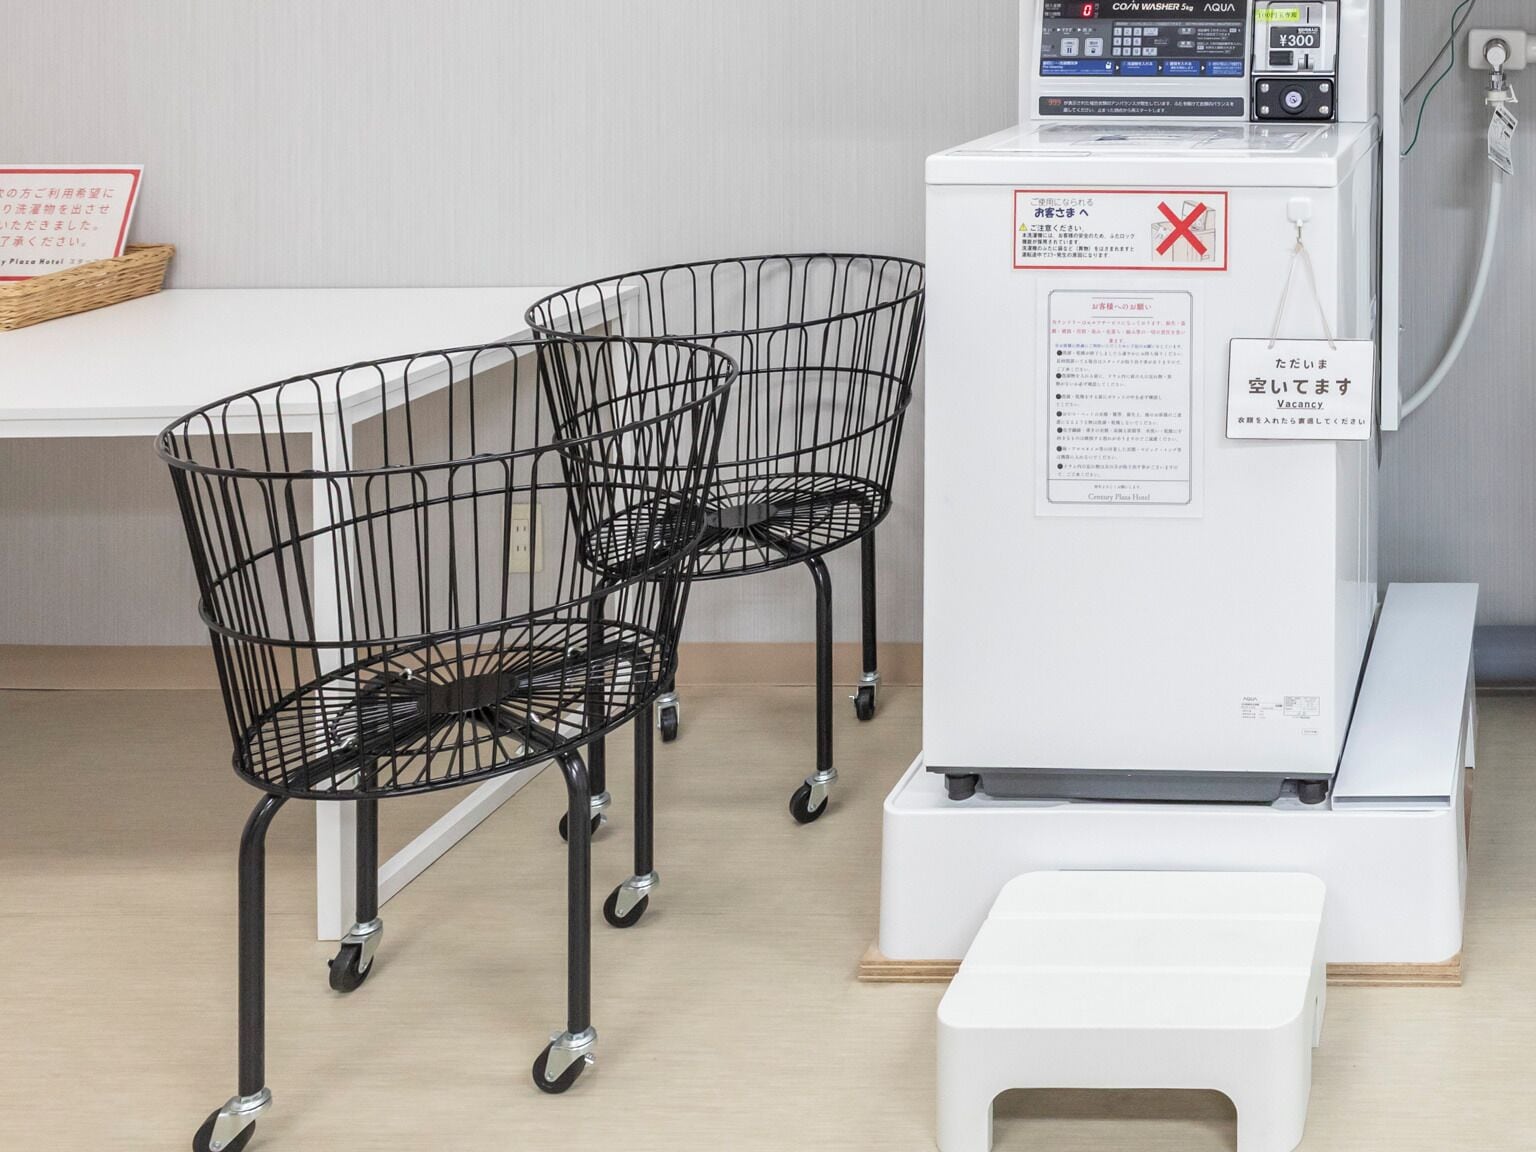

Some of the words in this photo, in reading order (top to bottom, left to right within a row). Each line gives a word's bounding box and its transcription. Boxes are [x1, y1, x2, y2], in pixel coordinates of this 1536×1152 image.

[1083, 5, 1092, 16] 0
[1141, 3, 1180, 11] WASHER
[1203, 3, 1235, 12] AQUA
[1280, 35, 1314, 47] ¥300
[1030, 198, 1093, 207] ご使用になられる
[1275, 358, 1327, 369] ただいま
[1248, 377, 1351, 396] 空いてます
[1277, 399, 1324, 409] Vacancy
[1088, 493, 1113, 501] Century
